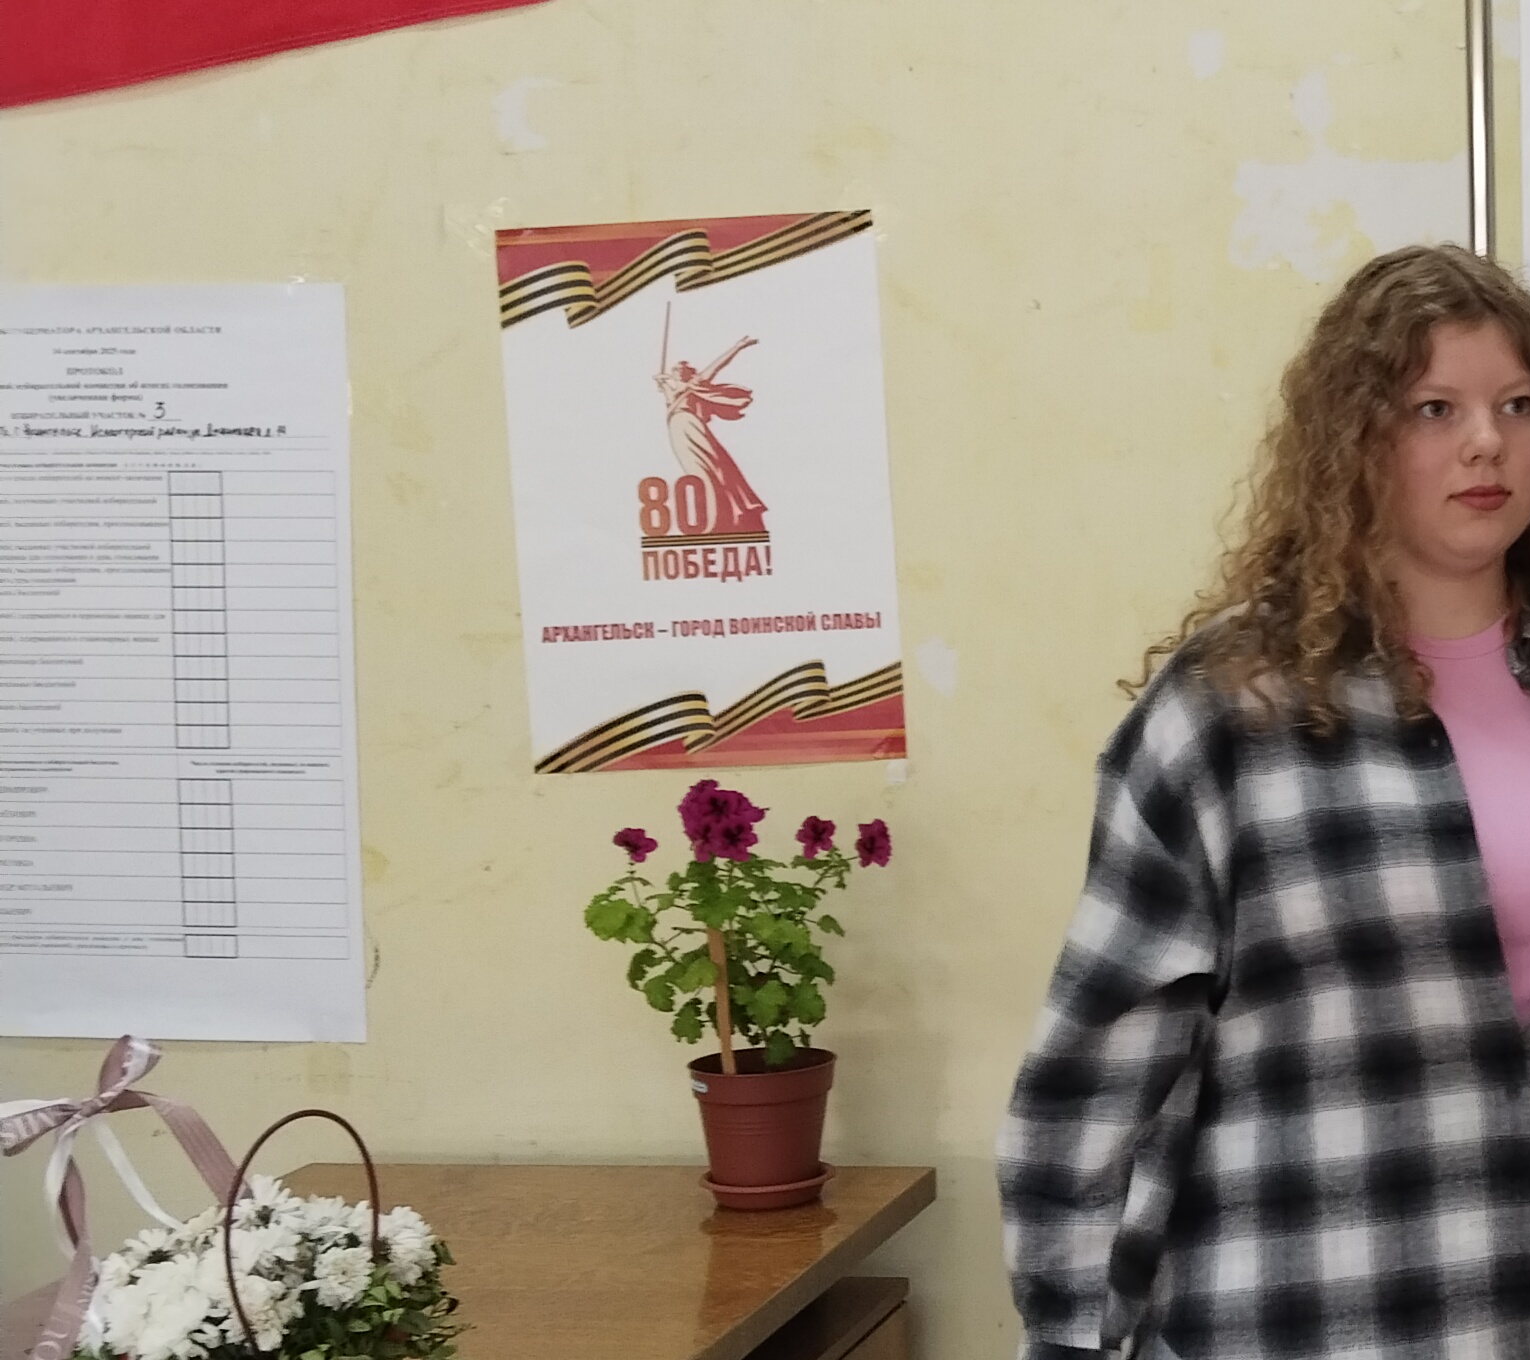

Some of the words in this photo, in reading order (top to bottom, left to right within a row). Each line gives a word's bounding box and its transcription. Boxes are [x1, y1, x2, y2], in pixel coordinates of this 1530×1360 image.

[637, 474, 709, 538] 80
[642, 545, 773, 582] ПОБЕДА!
[542, 622, 655, 644] АРХАНГЕЛЬСК
[671, 618, 726, 639] ГОРОД
[730, 612, 817, 635] ВОИНСКОЙ
[820, 611, 882, 631] СЛАВЫ
